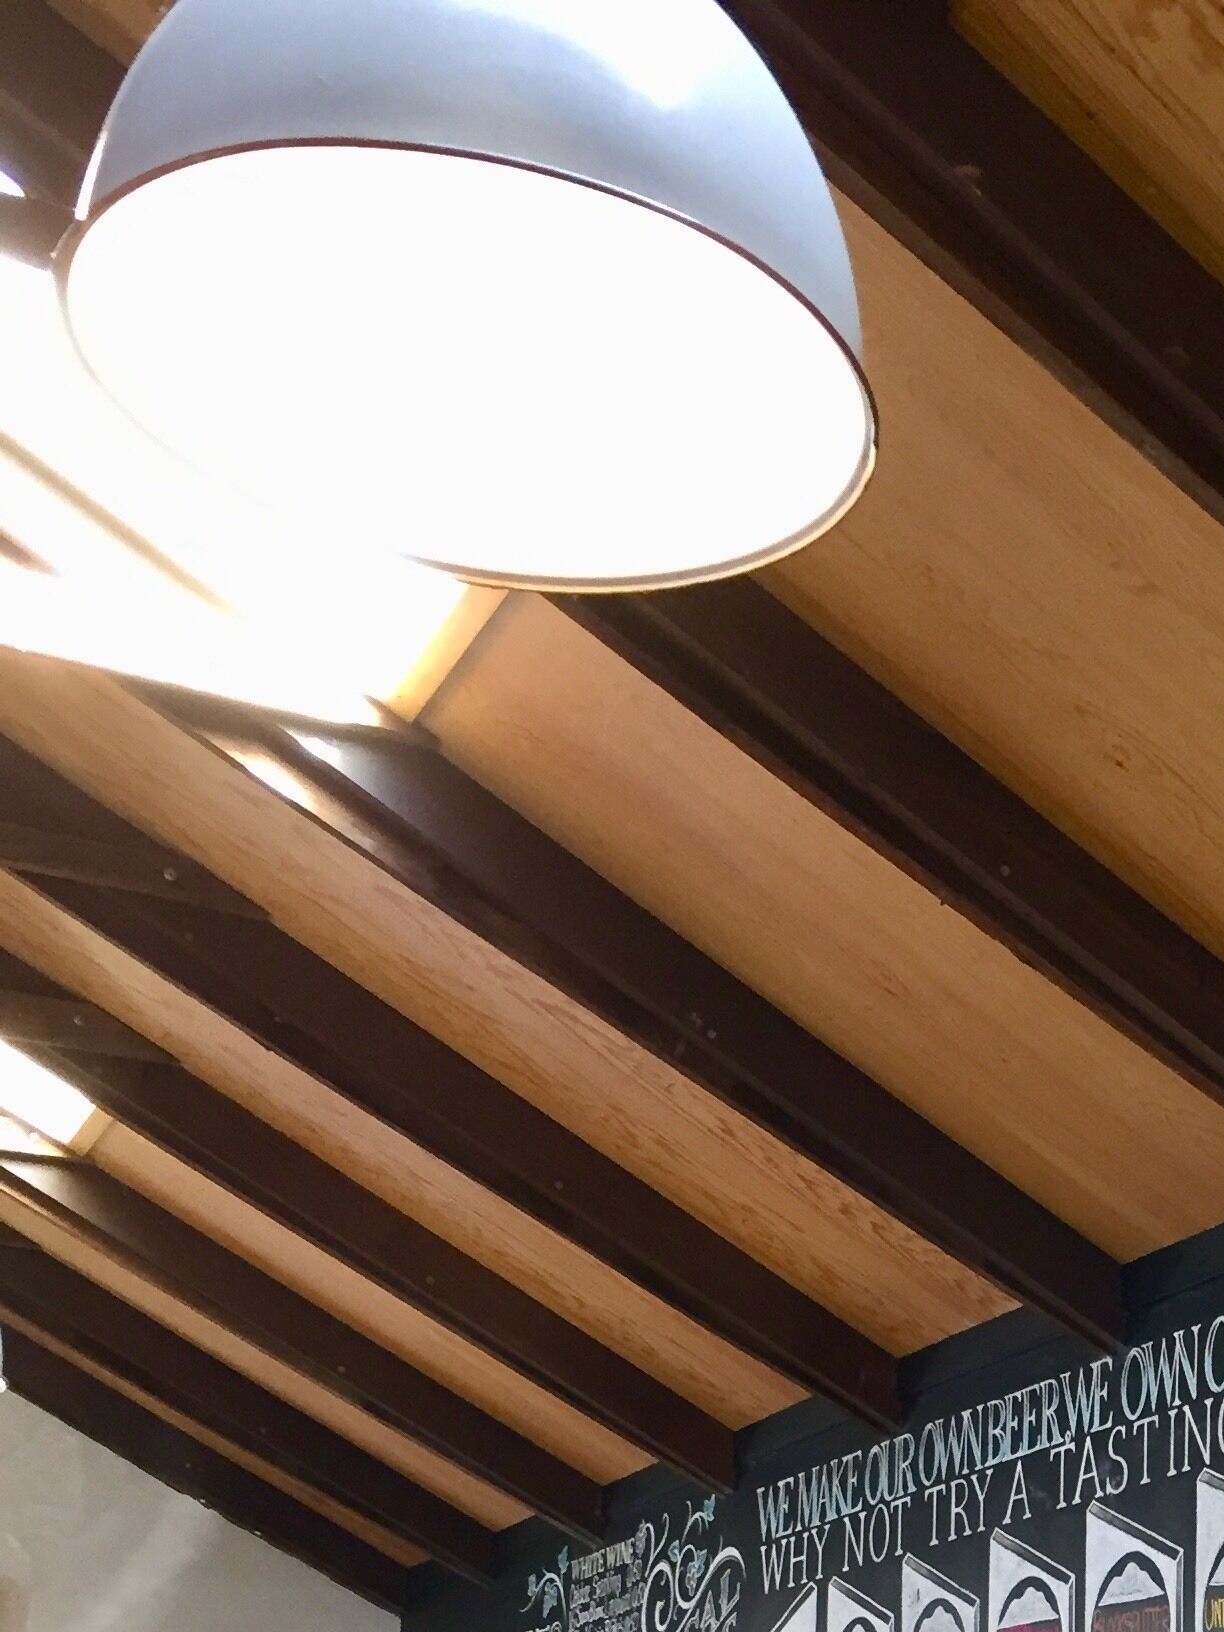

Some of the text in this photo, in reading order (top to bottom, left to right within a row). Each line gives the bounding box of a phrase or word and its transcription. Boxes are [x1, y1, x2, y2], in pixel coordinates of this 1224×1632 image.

[756, 1477, 795, 1543] WE
[796, 1451, 863, 1531] MAKE
[865, 1433, 918, 1506] OUR
[919, 1404, 983, 1486] OWN
[1060, 1356, 1113, 1436] WE
[1120, 1324, 1201, 1421] OWN
[571, 1548, 605, 1580] WHITE
[760, 1525, 831, 1595] WHY
[842, 1495, 912, 1573] NOT
[924, 1468, 993, 1547] TRY
[1002, 1459, 1032, 1525] A
